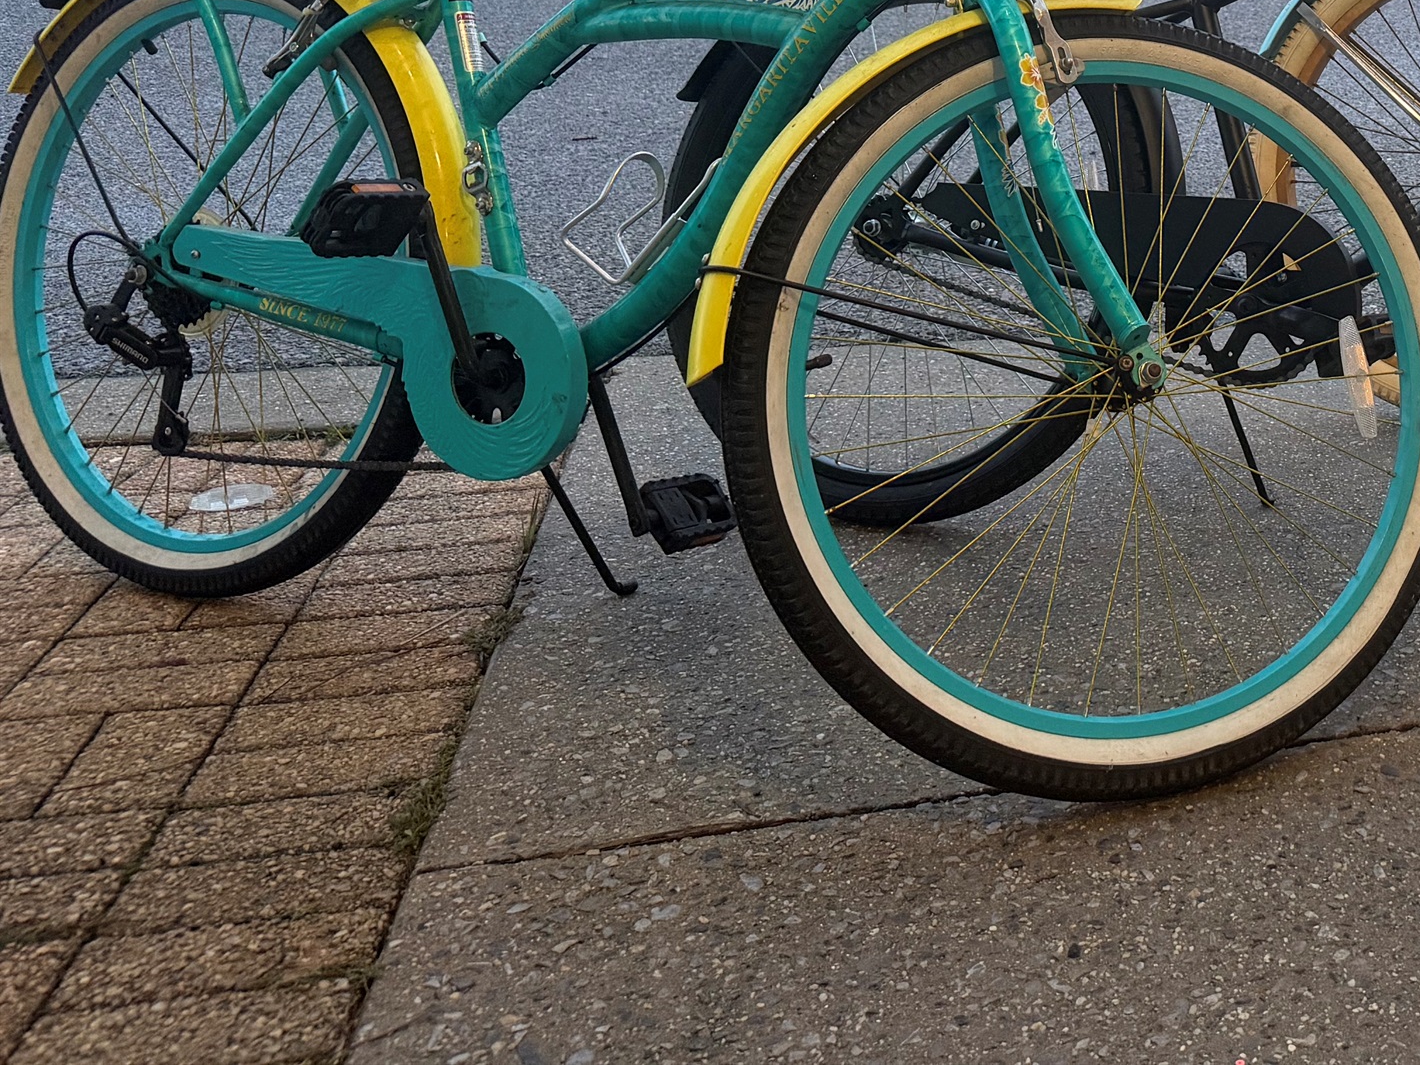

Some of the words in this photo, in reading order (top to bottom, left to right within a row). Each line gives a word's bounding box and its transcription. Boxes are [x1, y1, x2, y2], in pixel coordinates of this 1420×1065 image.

[259, 297, 312, 323] SINCE
[313, 311, 349, 332] 1977
[111, 337, 149, 364] SHIMANO
